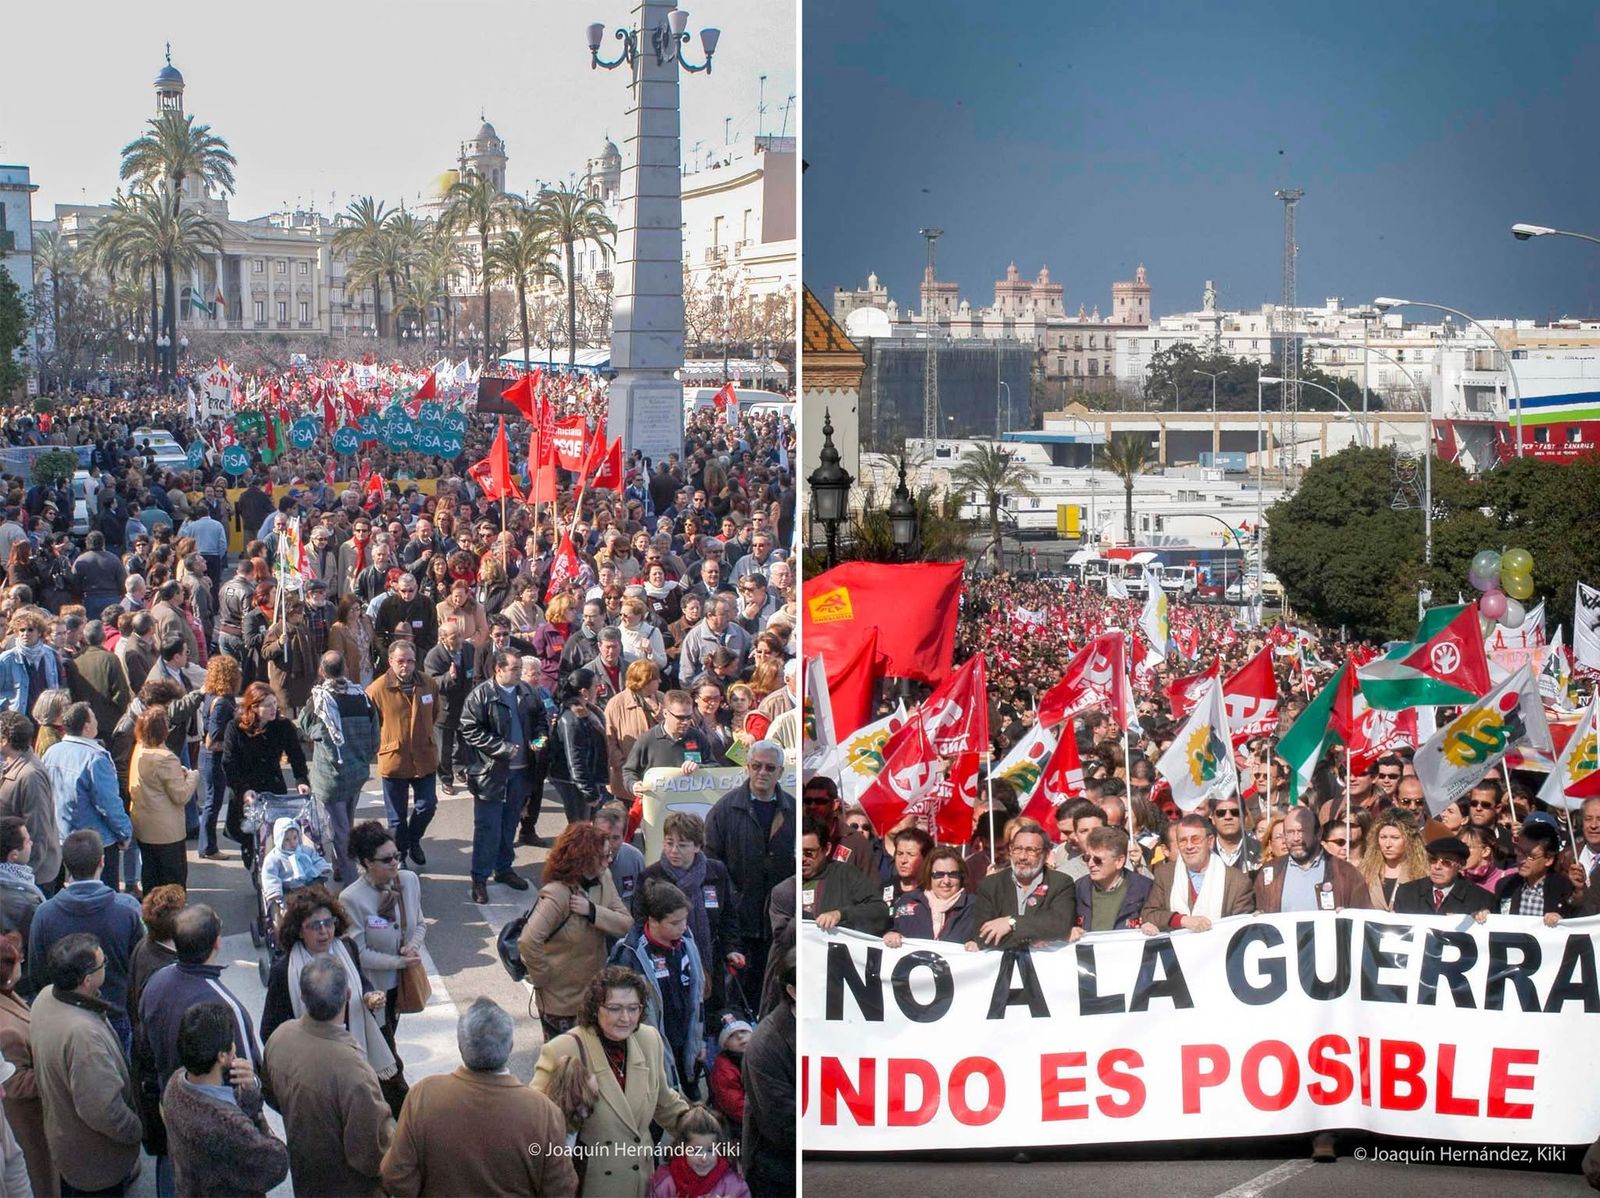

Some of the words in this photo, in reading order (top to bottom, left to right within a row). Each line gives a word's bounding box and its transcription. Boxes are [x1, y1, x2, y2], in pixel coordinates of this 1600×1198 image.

[421, 409, 441, 421] PSA
[362, 424, 377, 435] SA
[390, 422, 413, 434] PSA
[443, 417, 465, 432] PSA
[293, 429, 313, 441] PSA
[335, 435, 358, 448] PSA
[419, 435, 441, 448] PSA
[443, 439, 461, 452] SA
[223, 454, 248, 467] PSA
[653, 775, 717, 792] FACUA
[825, 942, 954, 1023] NO
[986, 943, 1050, 1020] A
[1076, 937, 1195, 1017] LA
[1225, 918, 1600, 1014] GUERRA
[1040, 1049, 1146, 1121] ES
[1181, 1033, 1540, 1120] POSIBLE
